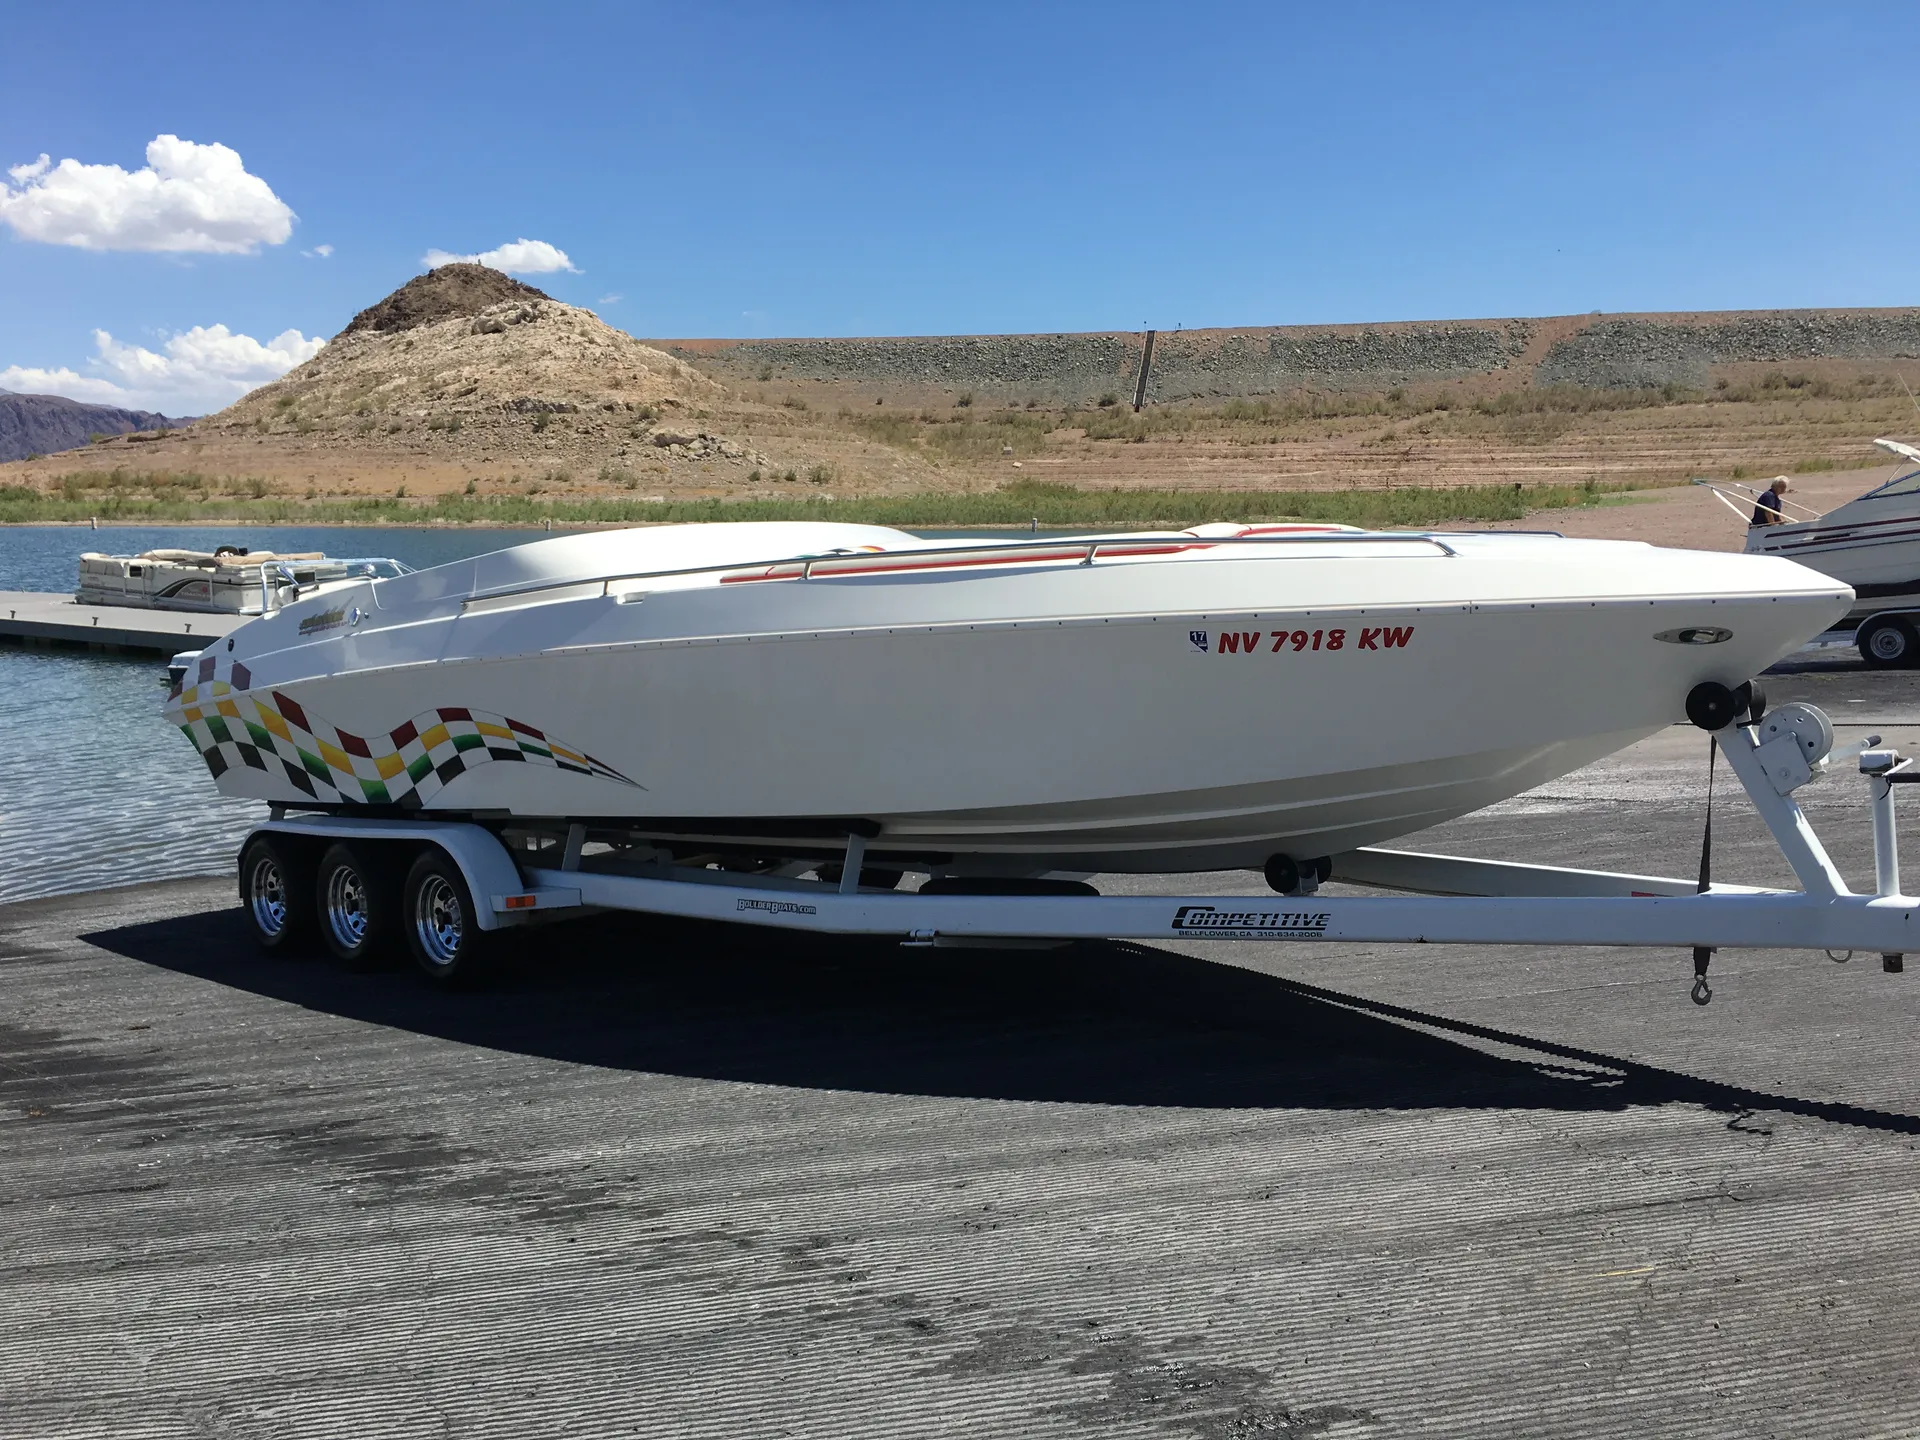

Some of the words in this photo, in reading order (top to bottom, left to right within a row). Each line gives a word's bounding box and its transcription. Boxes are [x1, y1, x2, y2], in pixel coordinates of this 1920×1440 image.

[1191, 631, 1205, 641] 17
[1218, 632, 1261, 654] NV
[1270, 629, 1346, 652] 7918
[1357, 626, 1415, 651] KW
[1171, 906, 1331, 930] COMPETITIVE
